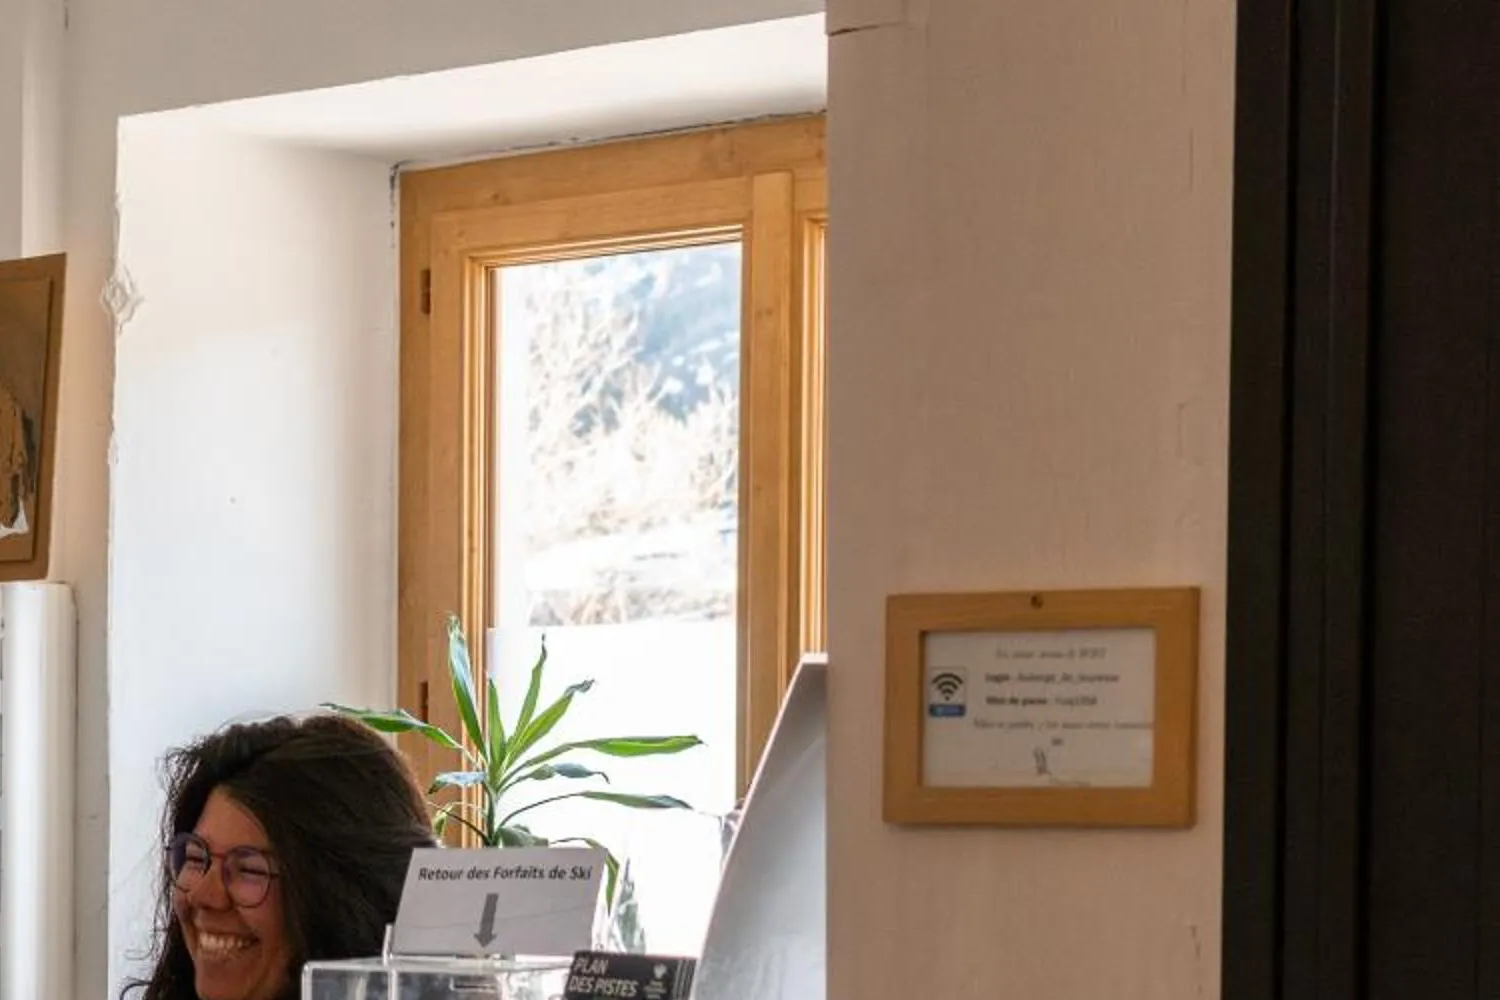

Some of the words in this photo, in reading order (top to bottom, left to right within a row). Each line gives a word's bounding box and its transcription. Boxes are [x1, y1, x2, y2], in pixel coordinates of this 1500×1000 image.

[419, 867, 463, 881] Retour
[467, 866, 490, 880] des
[493, 865, 545, 880] Forfaits
[548, 865, 566, 880] de
[569, 865, 592, 880] Ski
[574, 957, 609, 974] PLAN
[569, 975, 594, 993] DES
[595, 977, 639, 997] PISTES
